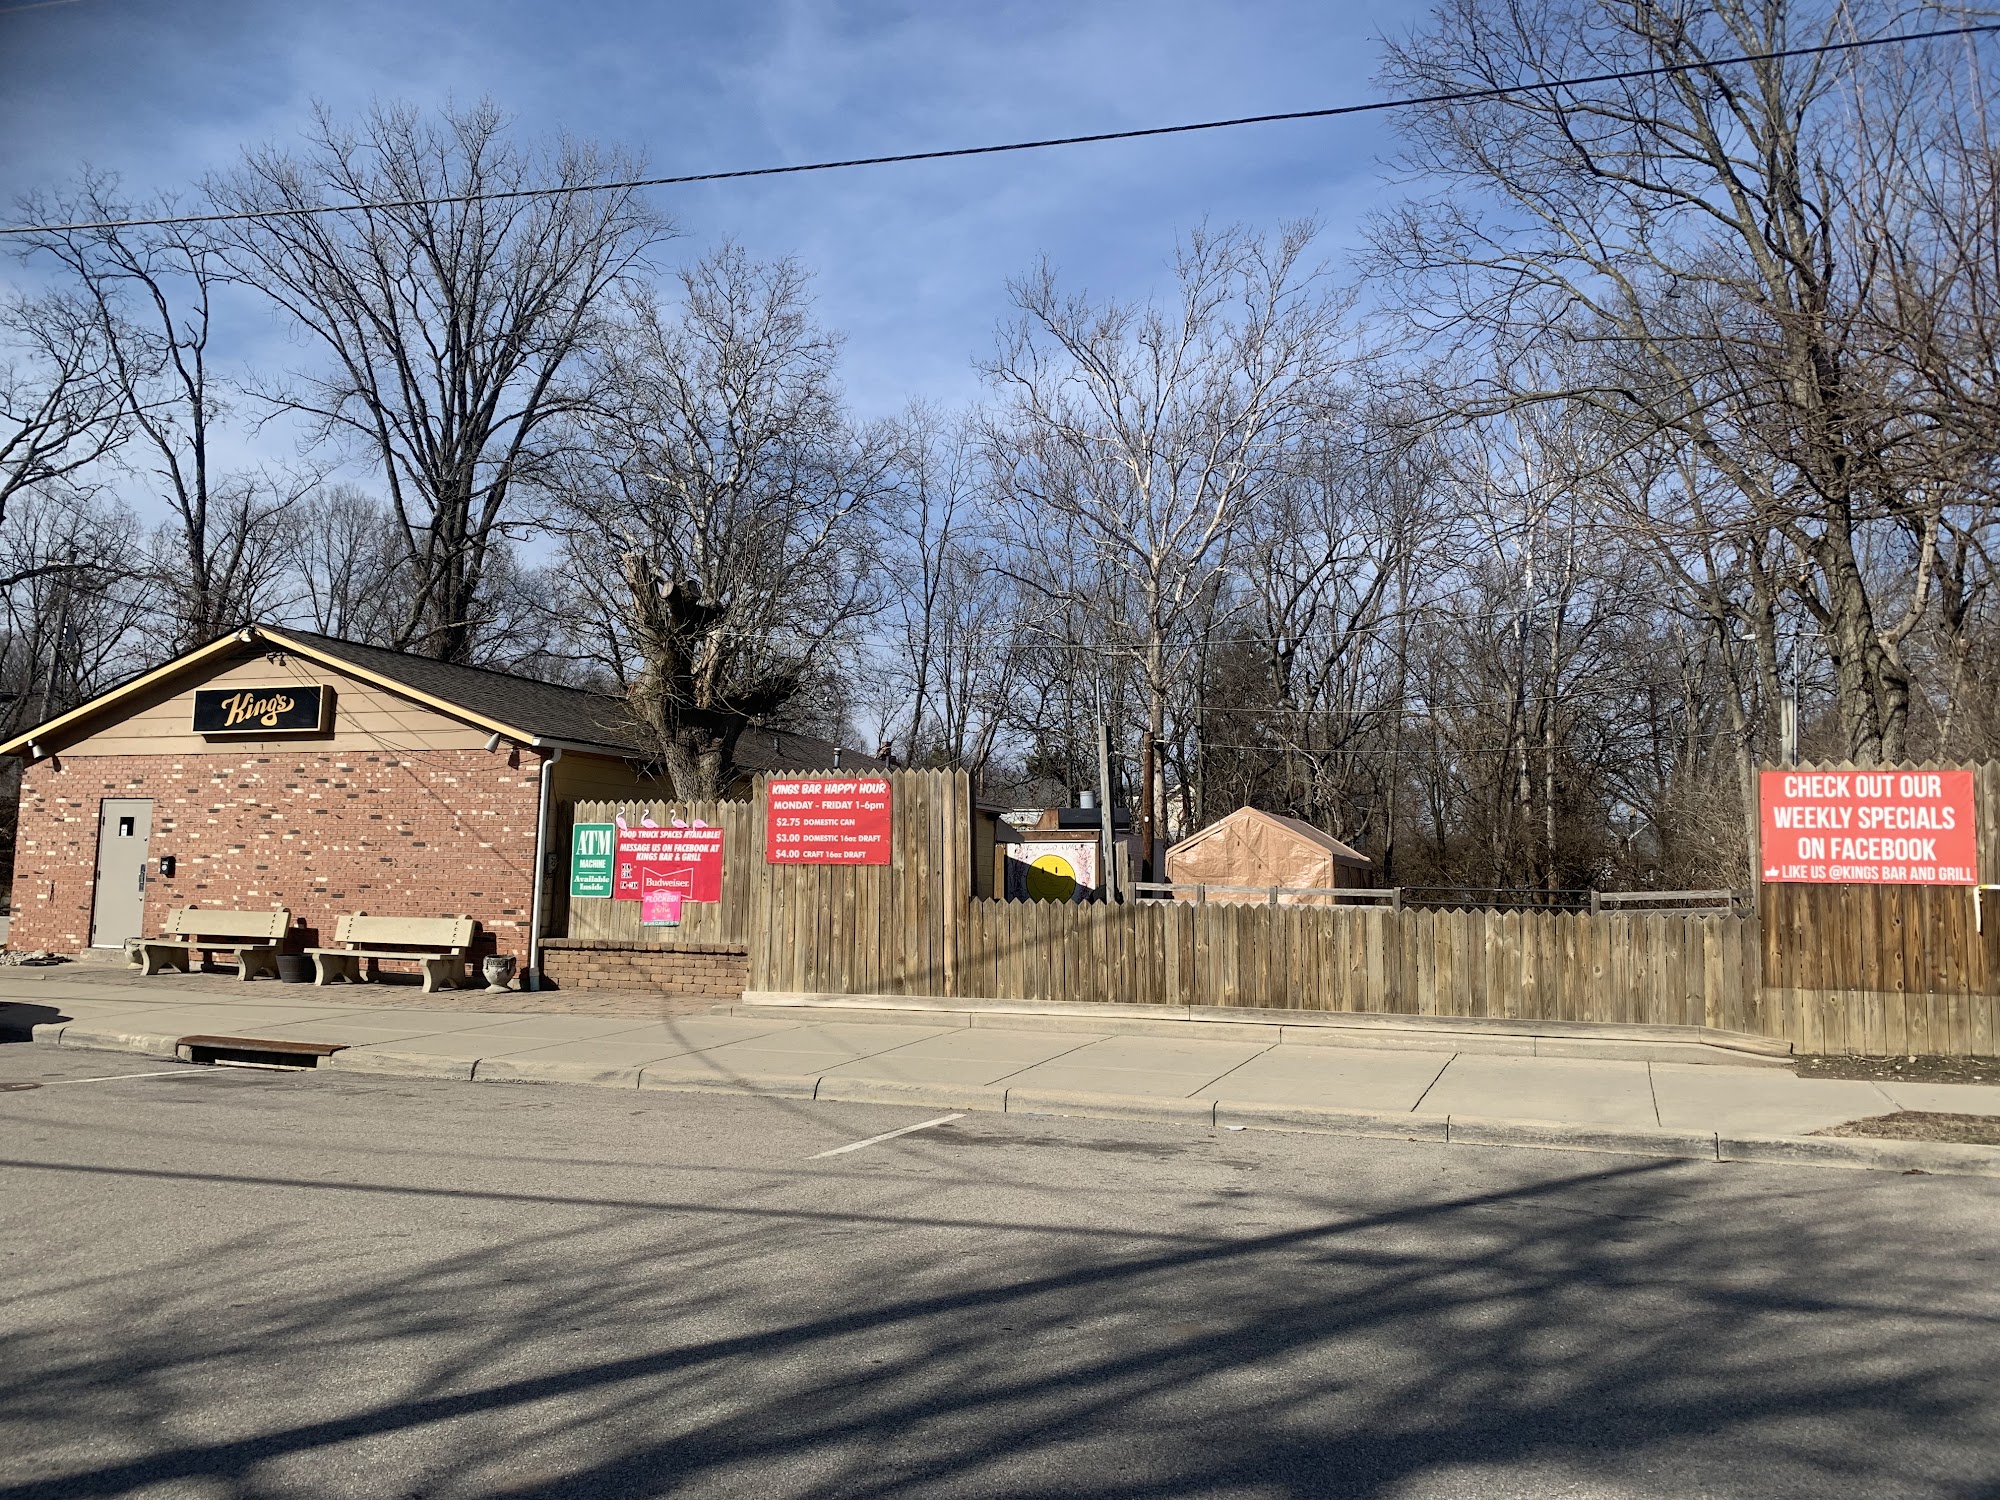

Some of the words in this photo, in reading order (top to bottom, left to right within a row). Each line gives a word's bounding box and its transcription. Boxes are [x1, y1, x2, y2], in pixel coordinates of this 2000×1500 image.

[221, 693, 295, 726] King's
[772, 784, 799, 794] KINGS
[802, 784, 822, 794] BAR
[824, 784, 857, 794] HAPPY
[859, 783, 886, 793] HOUR
[1785, 776, 1850, 797] CHECK
[1856, 776, 1894, 797] OUT
[1900, 776, 1941, 797] OUR
[774, 801, 813, 809] MONDAY
[822, 801, 853, 809] FRIDAY
[855, 801, 884, 810] 1-6pm
[776, 818, 800, 827] $2.75
[1774, 807, 1853, 828] WEEKLY
[1858, 807, 1955, 829] SPECIALS
[620, 830, 637, 838] FOOD
[638, 830, 659, 839] TRUCK
[660, 830, 682, 839] SPACES
[776, 834, 800, 843] $3.00
[575, 830, 611, 855] ATM
[620, 843, 651, 852] MESSAGE
[651, 844, 661, 852] US
[662, 844, 673, 852] ON
[674, 844, 709, 852] FACEBOOK
[710, 844, 720, 852] AT
[1798, 837, 1825, 859] ON
[1831, 837, 1936, 860] FACEBOOK
[636, 853, 658, 861] KINGS
[658, 853, 674, 861] BAR
[674, 853, 681, 861] &
[681, 853, 701, 861] GRILL
[775, 850, 799, 859] $4.00
[579, 859, 606, 868] MACHINE
[1782, 865, 1807, 878] LIKE
[1811, 866, 1826, 879] US
[1829, 865, 1879, 879] @KINGS
[1883, 866, 1907, 879] BAR
[1910, 867, 1935, 880] AND
[1939, 867, 1973, 881] GRILL
[574, 875, 609, 883] Available
[645, 895, 679, 903] FLOCKED!
